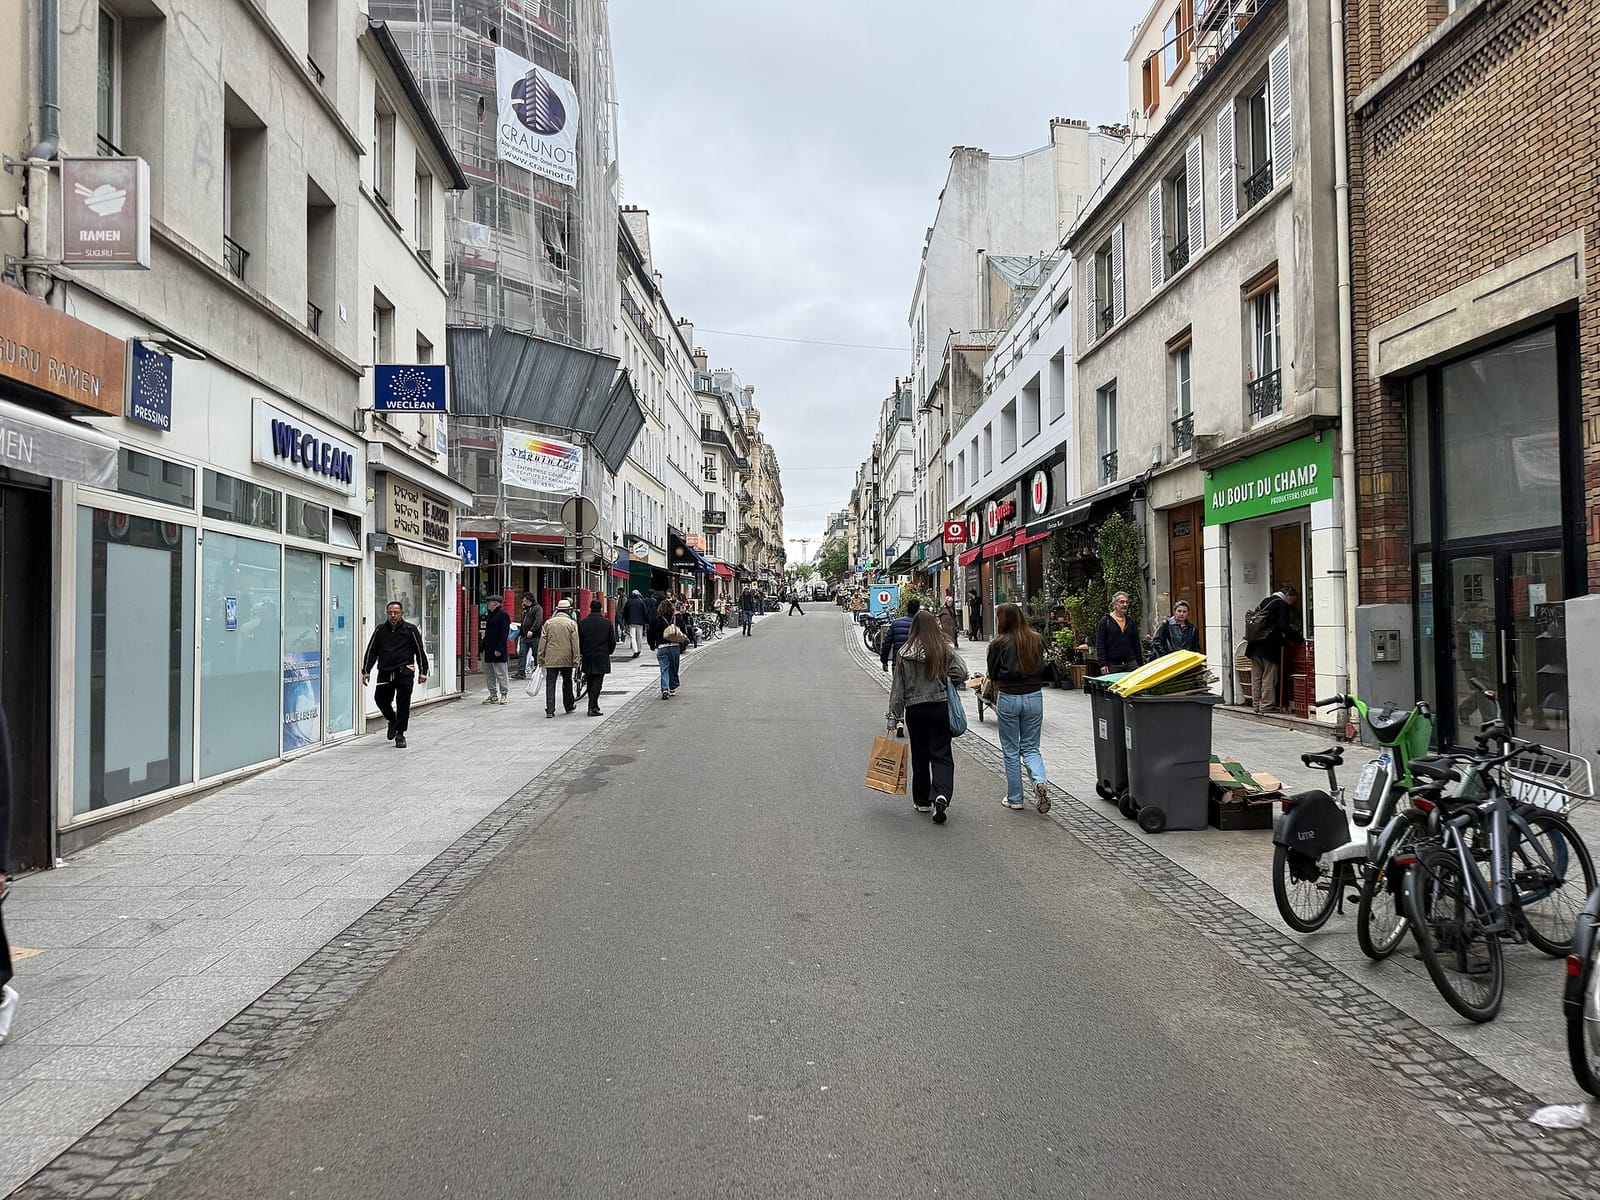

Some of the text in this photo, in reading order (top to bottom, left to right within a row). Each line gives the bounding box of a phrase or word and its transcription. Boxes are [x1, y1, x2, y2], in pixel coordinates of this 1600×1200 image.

[501, 123, 574, 167] CRAUNOT
[80, 230, 120, 241] RAMEN
[48, 356, 100, 397] RAMEN
[134, 404, 168, 428] PRESSING
[386, 400, 435, 409] WECLEAN
[272, 418, 352, 484] WECLEAN
[1034, 481, 1042, 504] U
[1212, 463, 1318, 510] AU BOUT DU CHAMP
[1270, 486, 1318, 505] PRODUCTEURS LOCAUX
[880, 594, 888, 602] U
